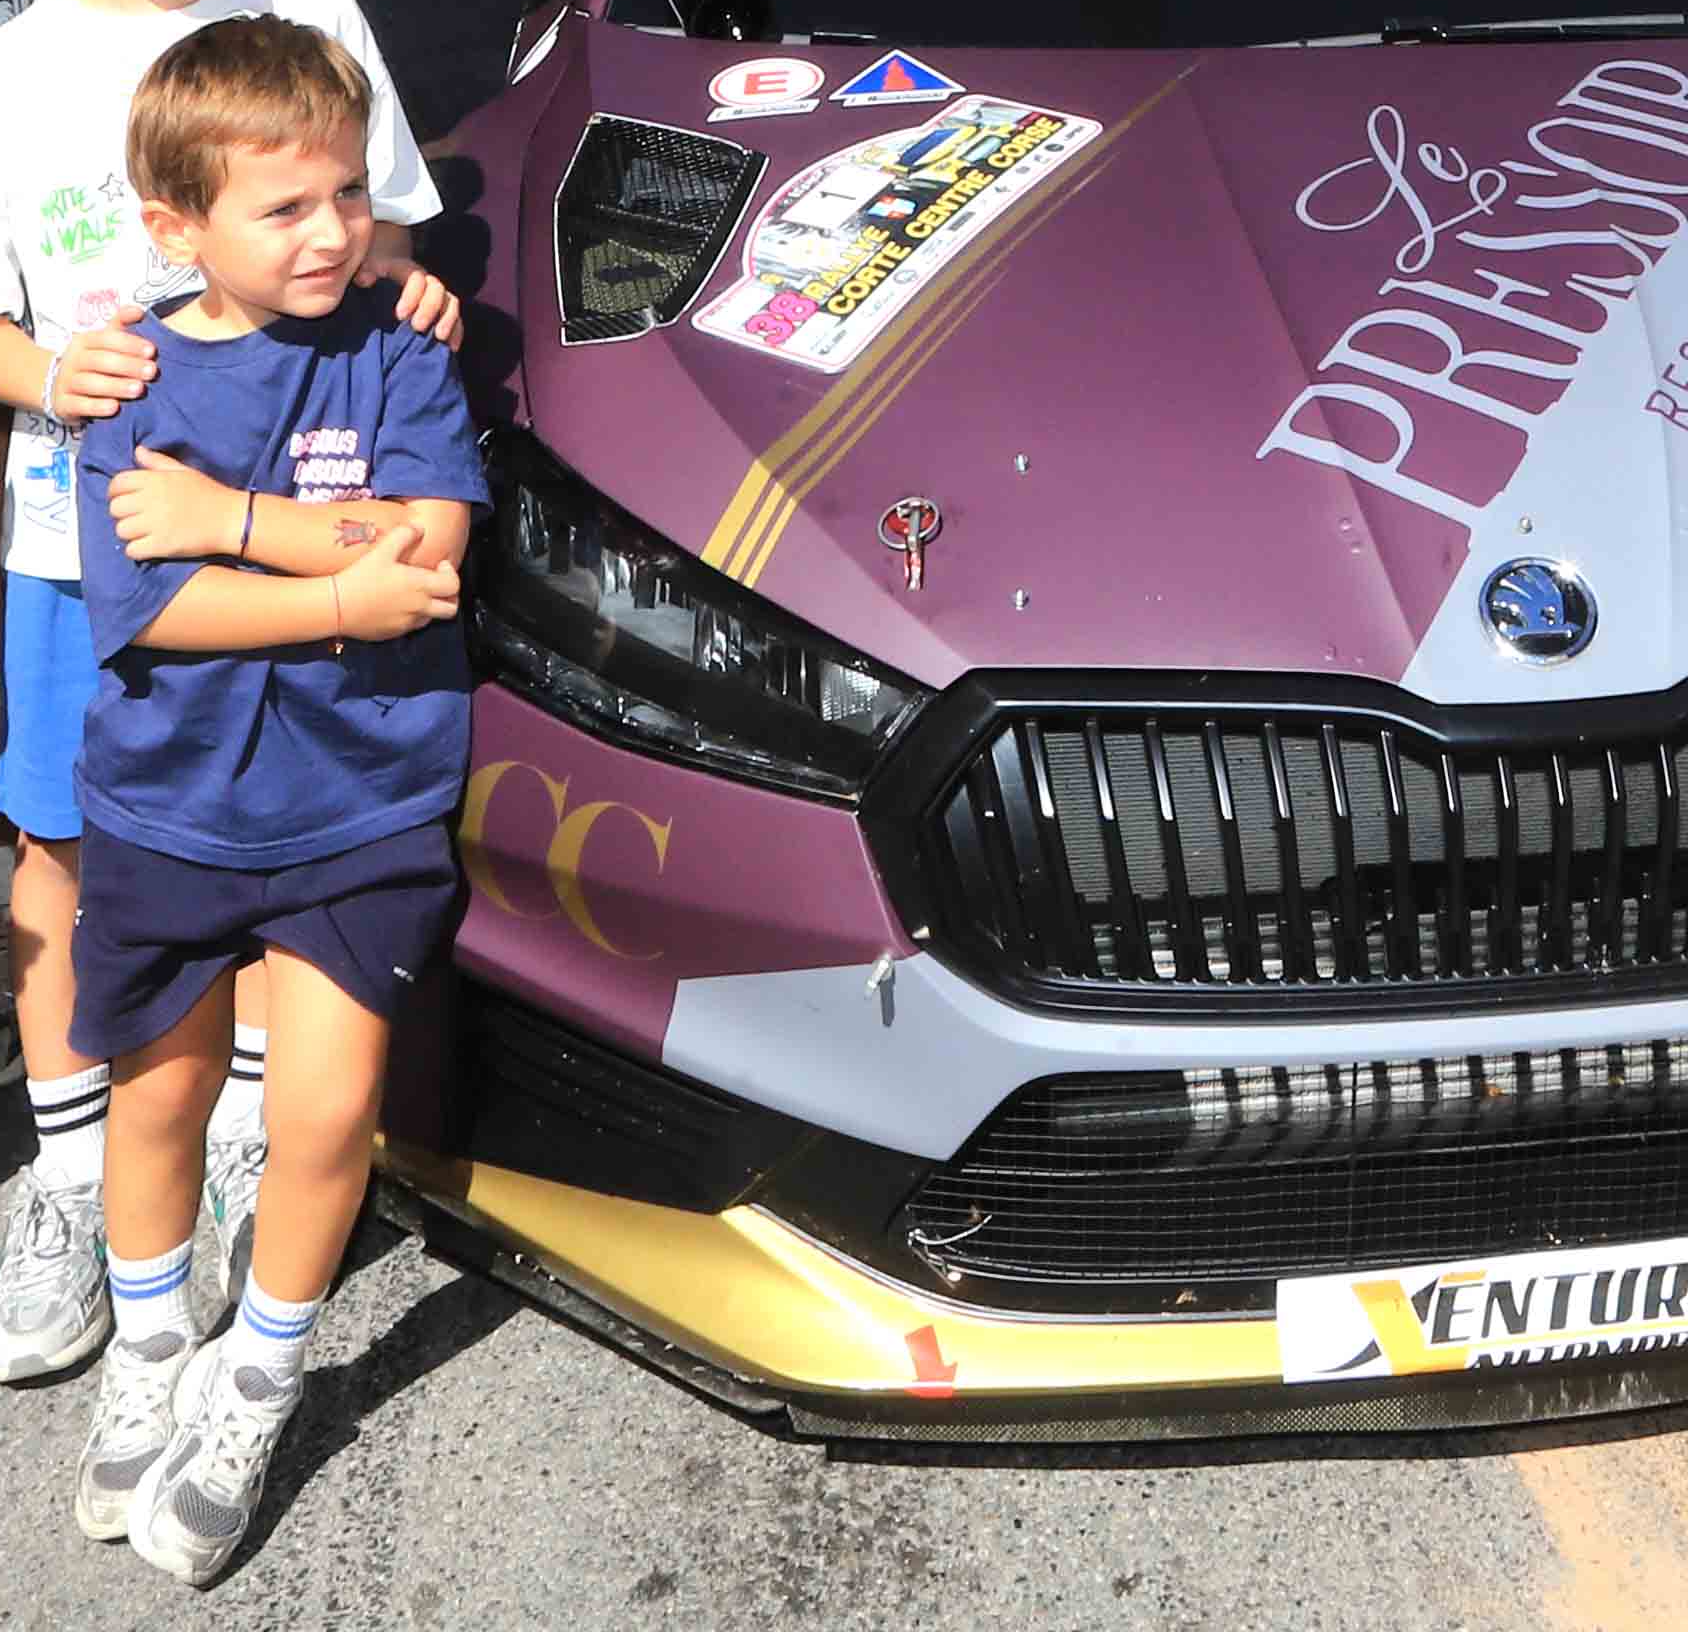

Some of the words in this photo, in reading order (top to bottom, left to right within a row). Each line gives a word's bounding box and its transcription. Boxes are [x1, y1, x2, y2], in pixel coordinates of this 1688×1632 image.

[825, 239, 913, 317] CORTE
[904, 167, 995, 241] CENTRE
[986, 113, 1065, 169] CORSE
[1295, 105, 1508, 273] Le
[744, 289, 820, 345] 38
[801, 223, 891, 300] RALLYE
